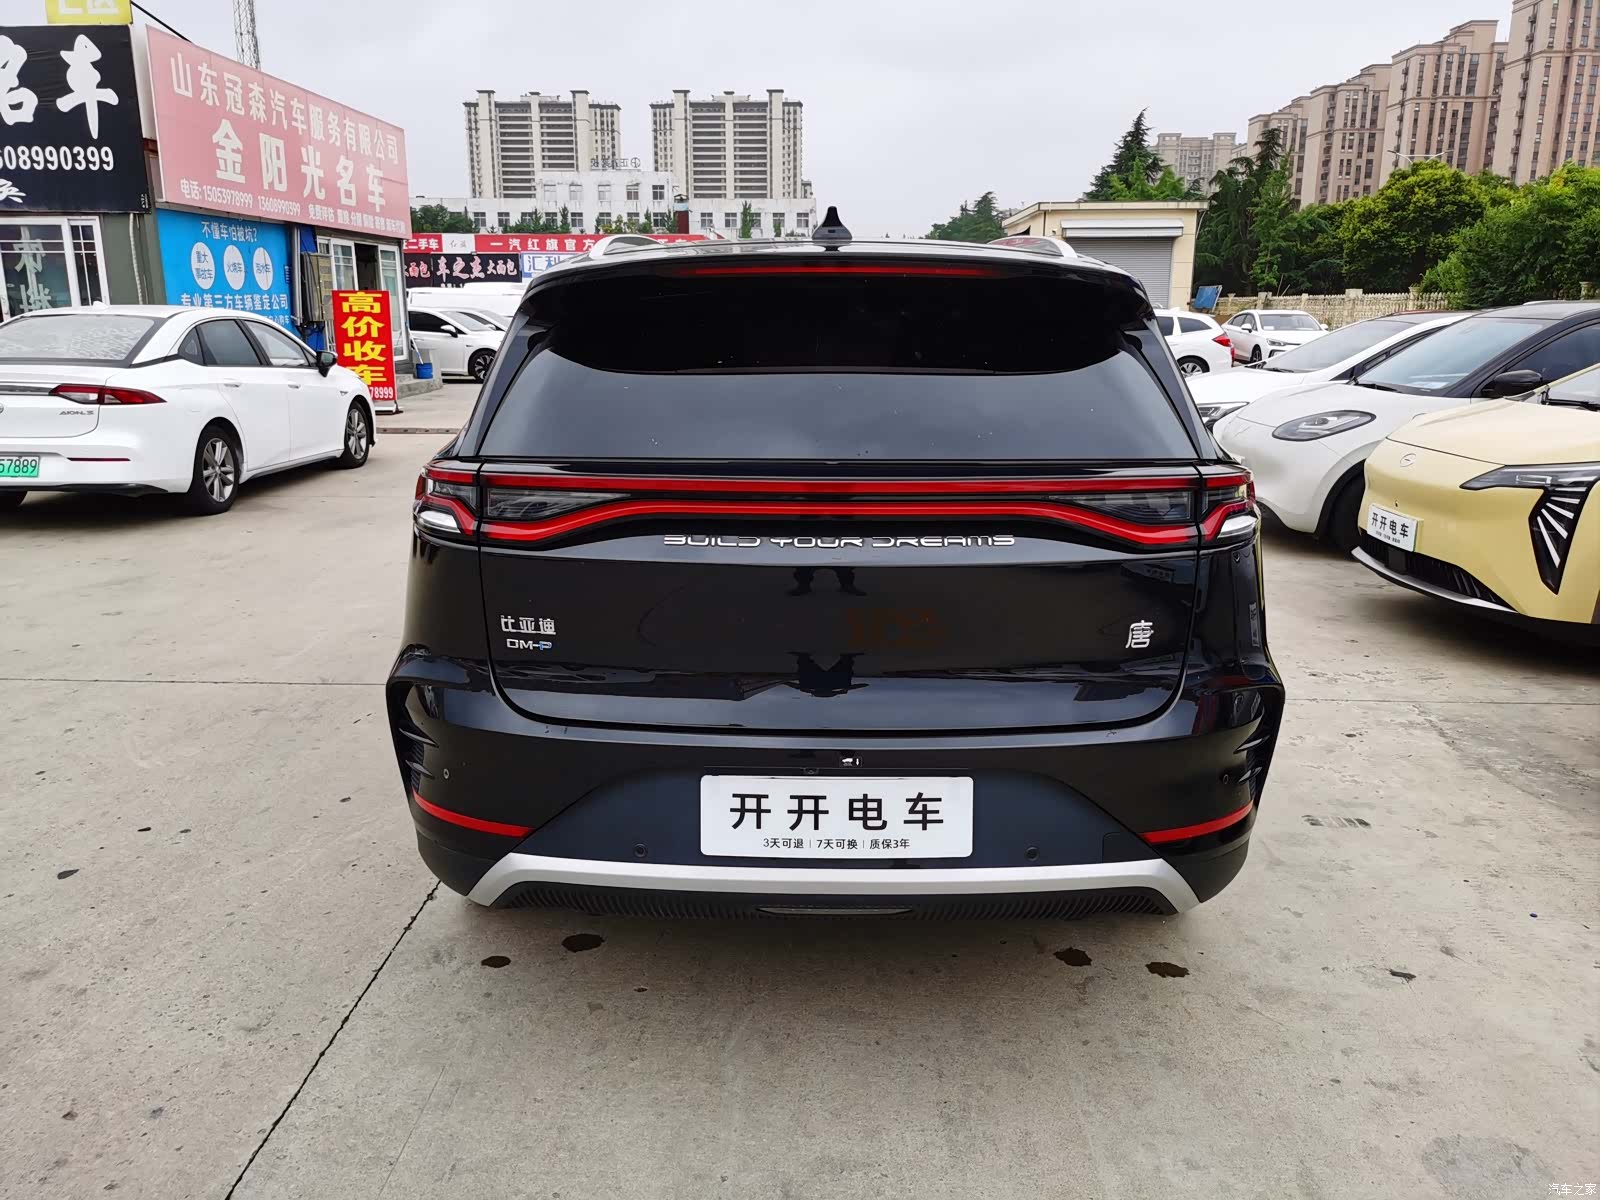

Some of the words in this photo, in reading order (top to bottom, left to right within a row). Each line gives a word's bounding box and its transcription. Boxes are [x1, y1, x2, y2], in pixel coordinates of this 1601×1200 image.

[170, 52, 399, 164] 山东冠森汽车服务有限公司
[212, 118, 386, 213] 金阳光名车
[258, 195, 301, 217] 13608990399
[339, 291, 387, 386] 高价收车
[1371, 511, 1409, 539] 开开电车
[664, 534, 760, 547] BUILD
[770, 535, 863, 548] YOUR
[872, 534, 1015, 548] DREAMS
[500, 614, 557, 635] 比亚迪
[1125, 619, 1154, 649] 唐
[506, 638, 552, 650] DM-P
[729, 791, 944, 832] 开开电车
[763, 837, 804, 849] 3天可退
[816, 838, 859, 850] 7天可换
[869, 837, 911, 850] 质保3年
